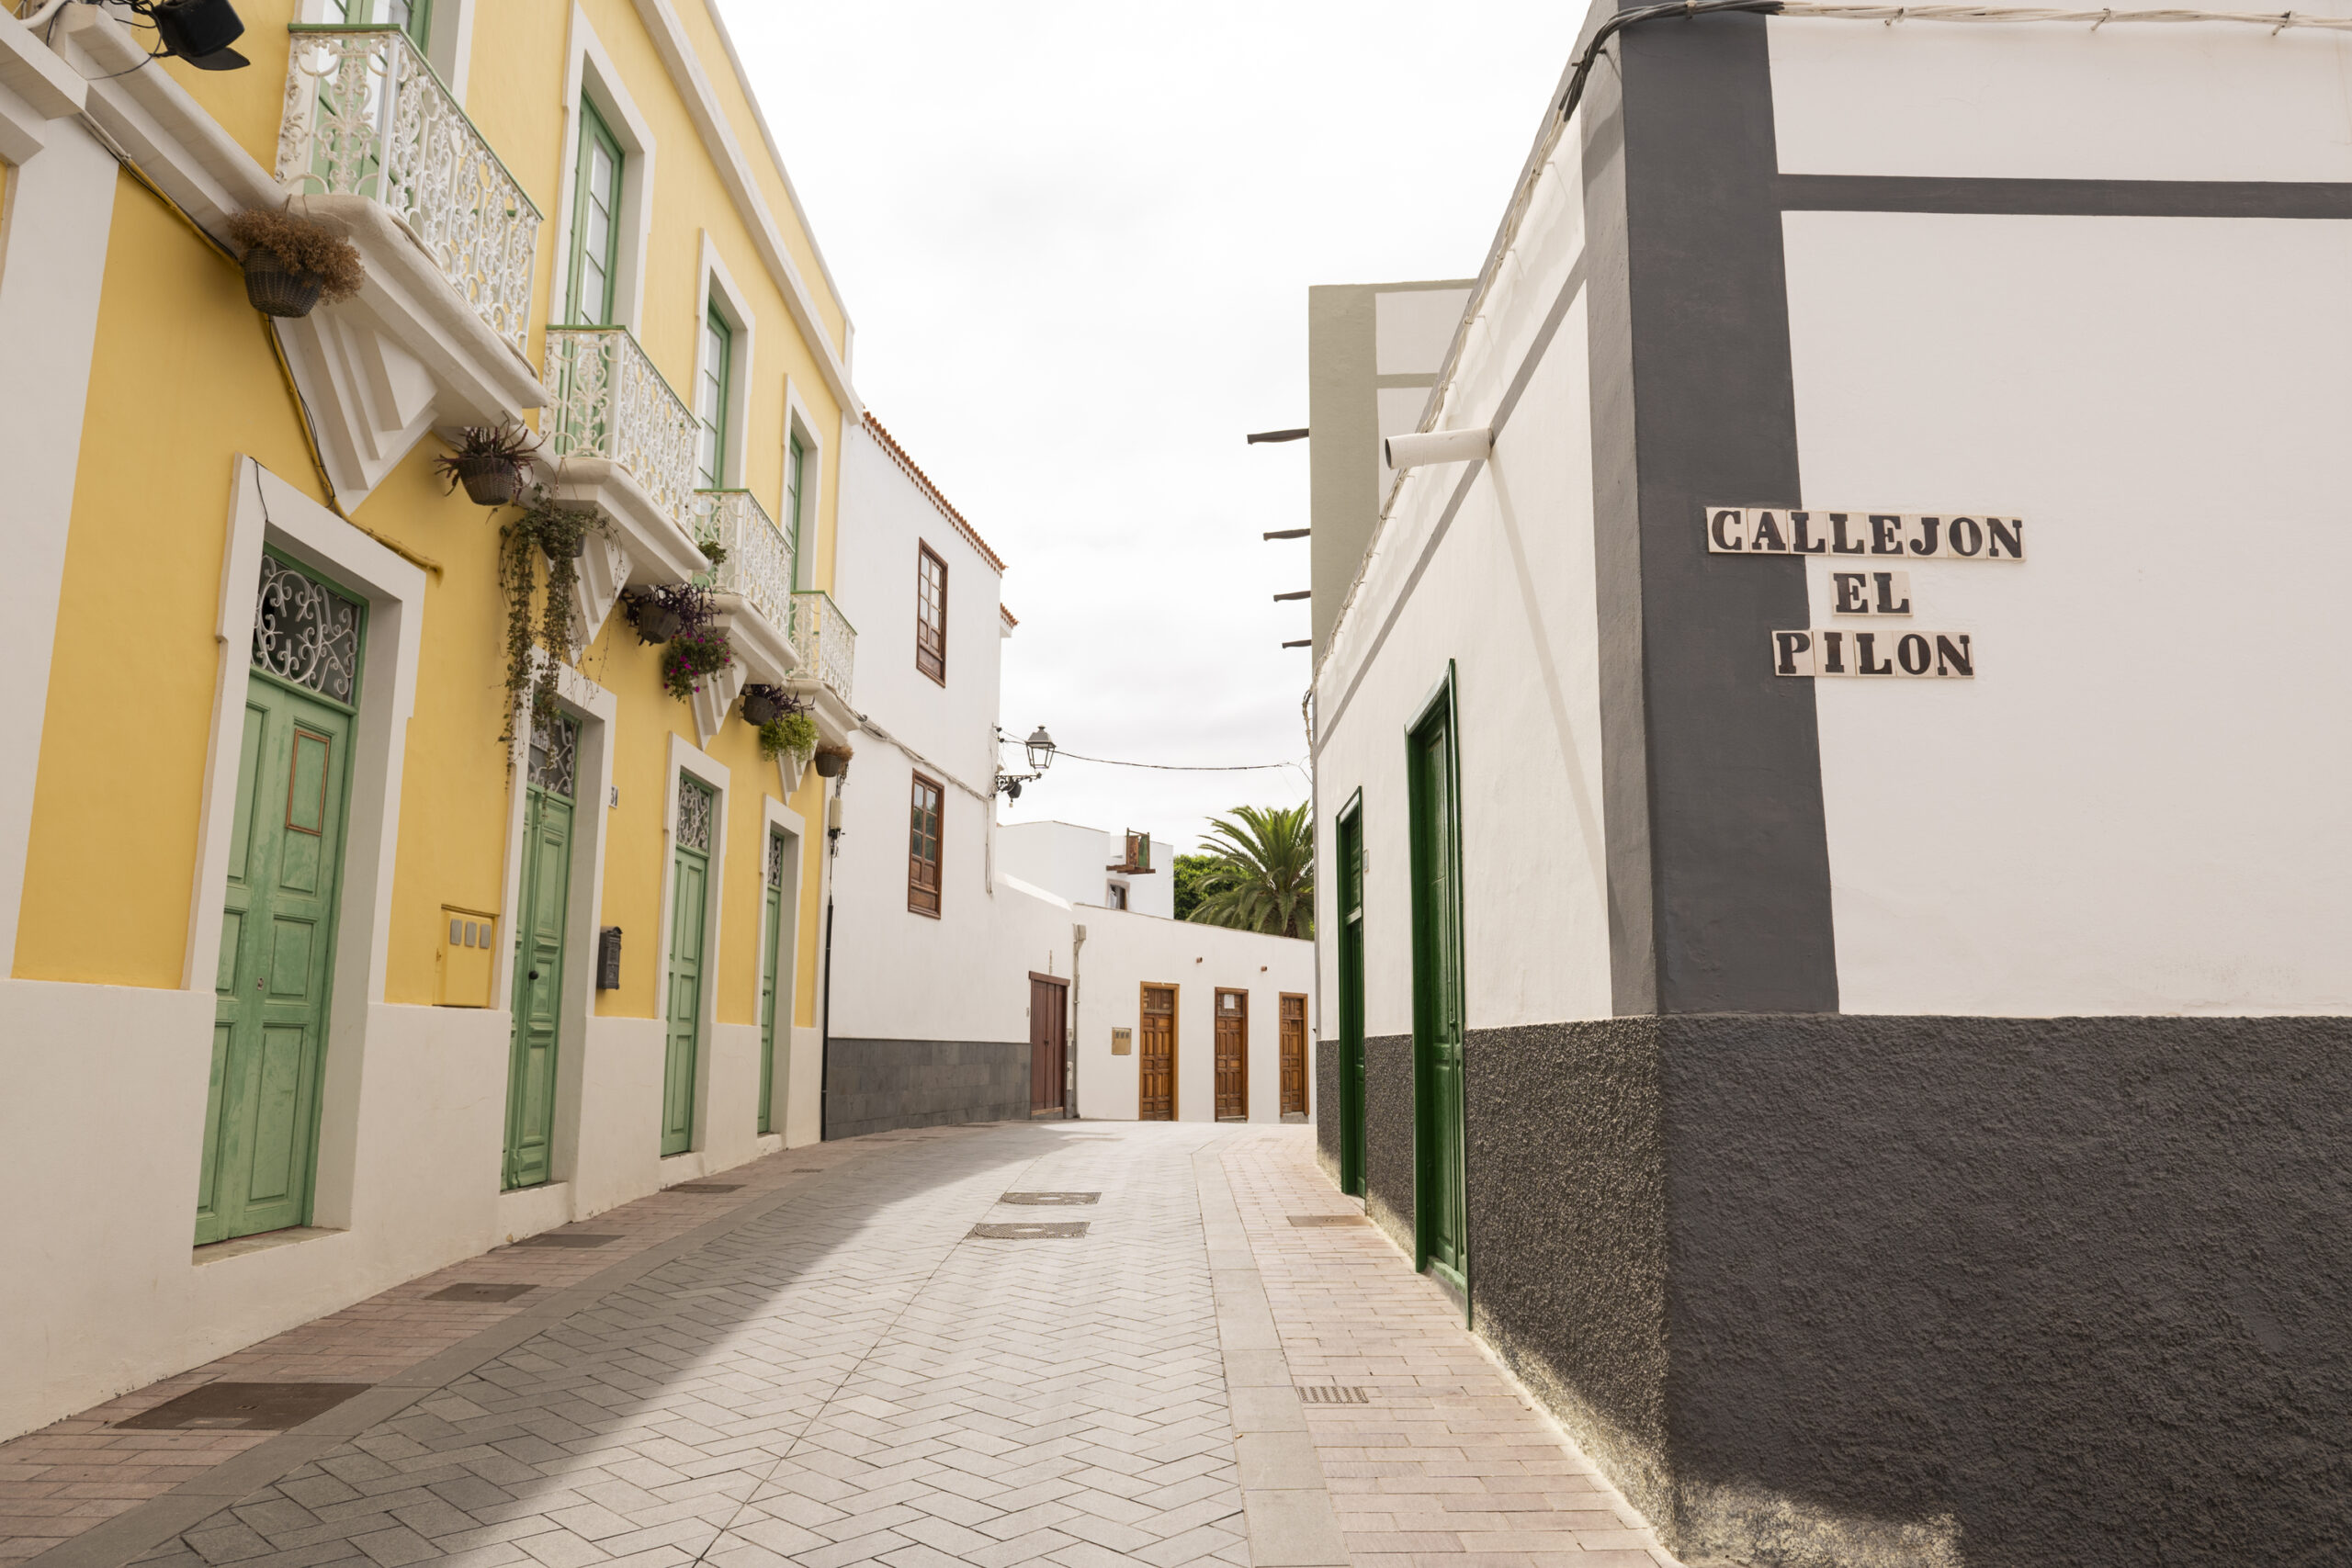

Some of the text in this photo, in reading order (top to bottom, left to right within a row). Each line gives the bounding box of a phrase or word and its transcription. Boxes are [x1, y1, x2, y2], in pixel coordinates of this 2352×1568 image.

[1712, 510, 2022, 558] CALLEJON
[1833, 571, 1910, 614] EL
[1776, 631, 1973, 676] PILON
